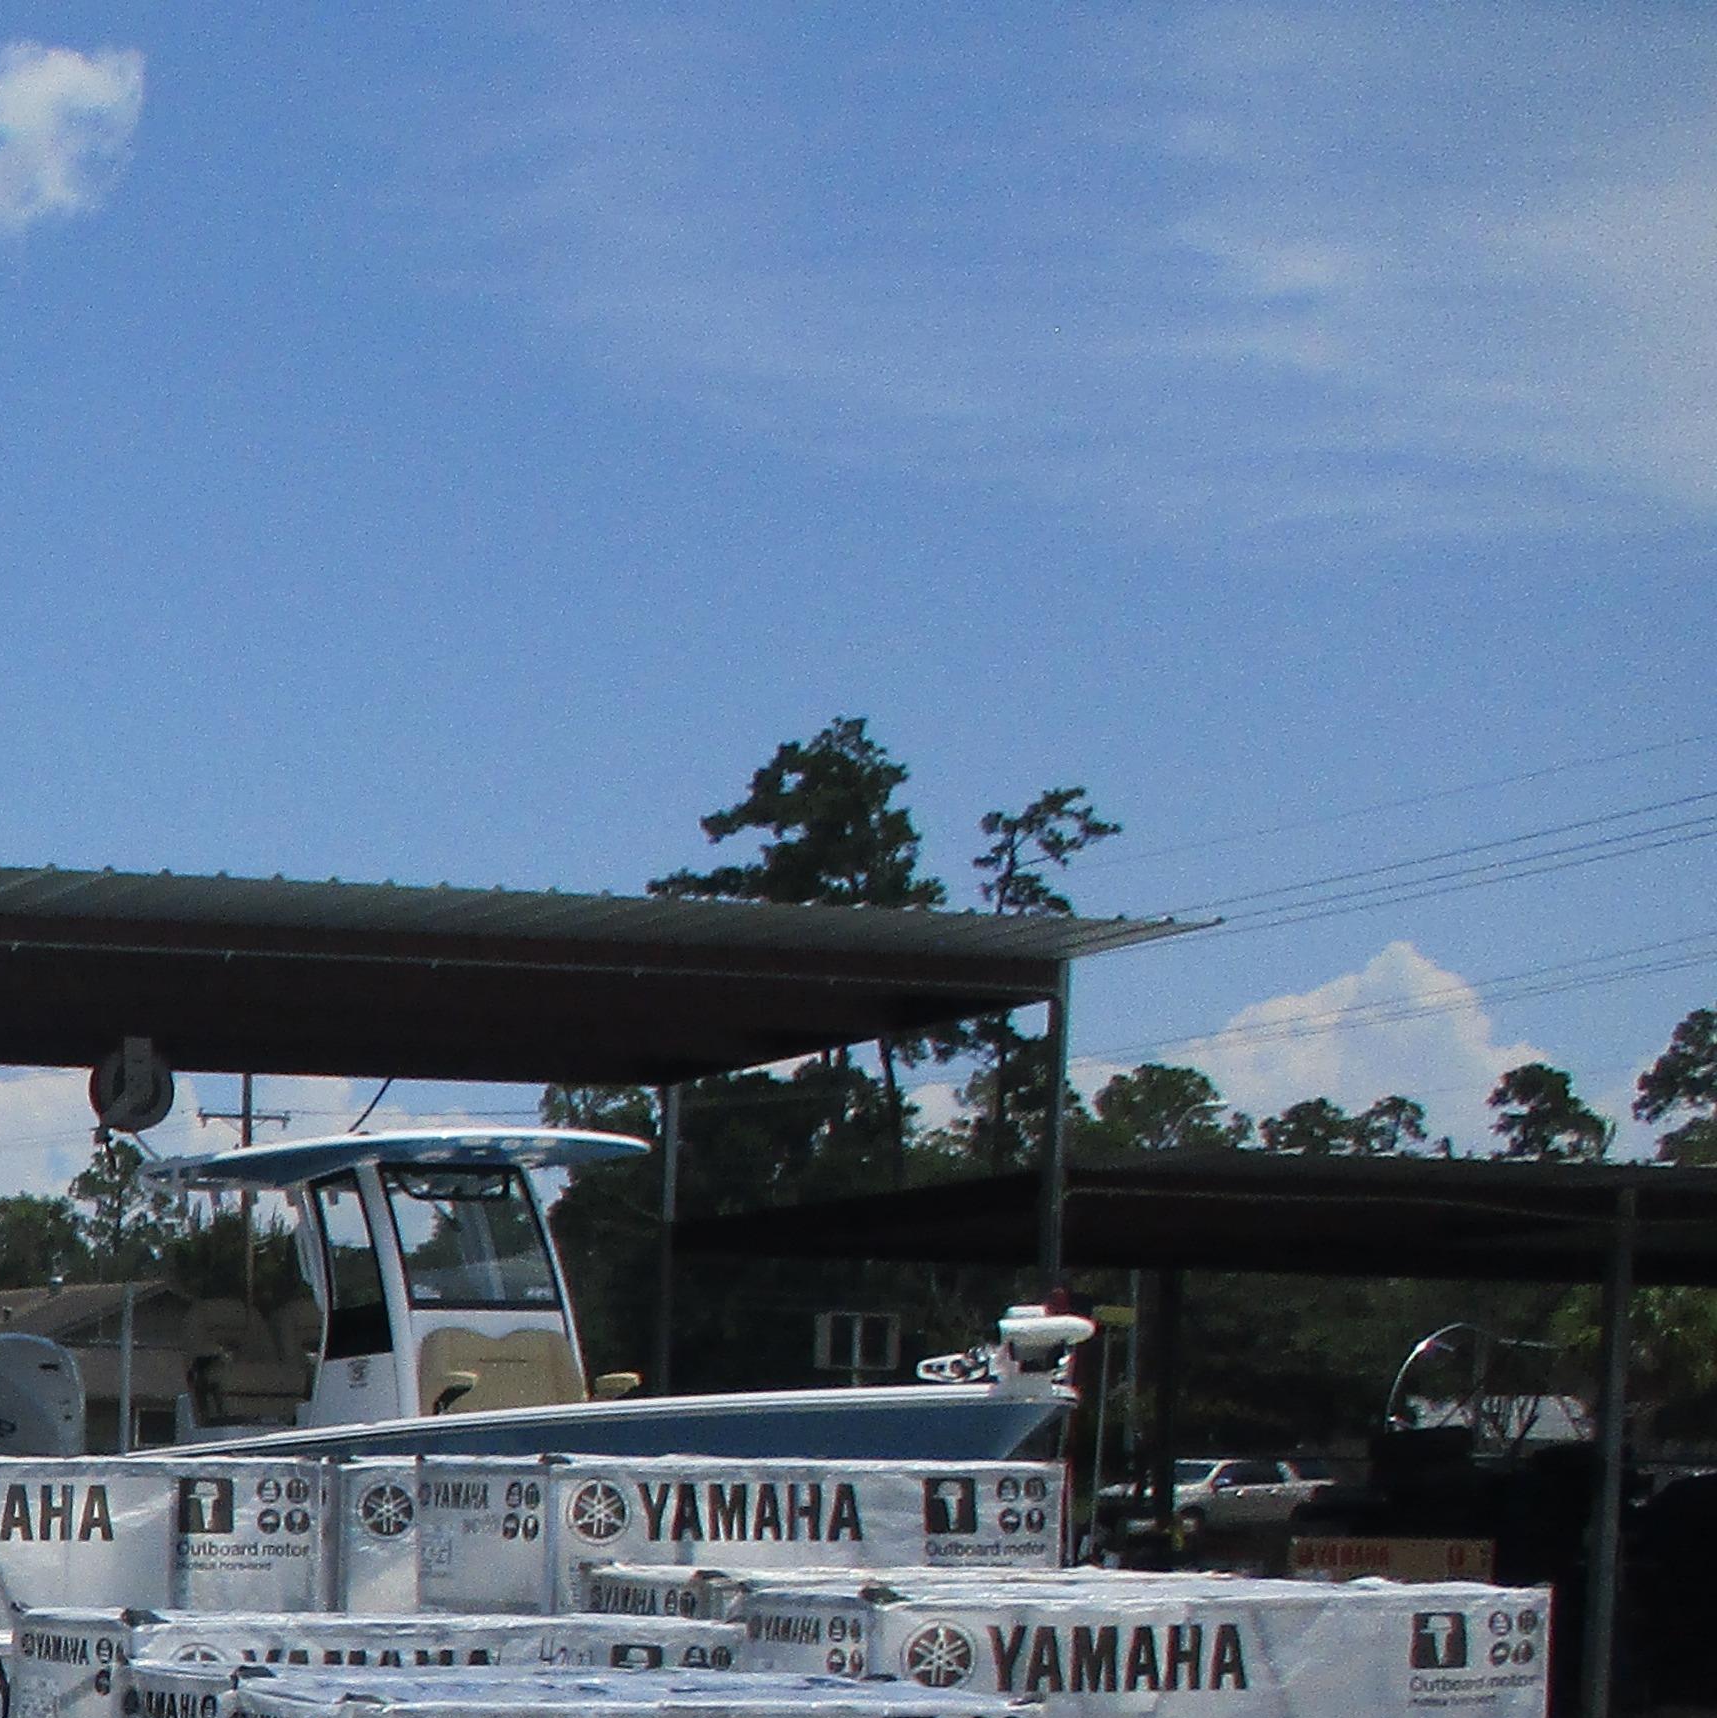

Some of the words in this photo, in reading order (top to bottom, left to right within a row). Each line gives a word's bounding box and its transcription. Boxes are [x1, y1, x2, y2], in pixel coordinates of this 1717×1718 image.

[433, 1482, 489, 1510] YAMAHA
[637, 1482, 864, 1541] YAMAHA
[176, 1541, 259, 1557] Outboard
[262, 1541, 310, 1557] motor
[925, 1541, 1001, 1557] Outboard
[1003, 1541, 1045, 1556] motor
[36, 1634, 90, 1666] YAMAHA
[986, 1624, 1249, 1692] YAMAHA
